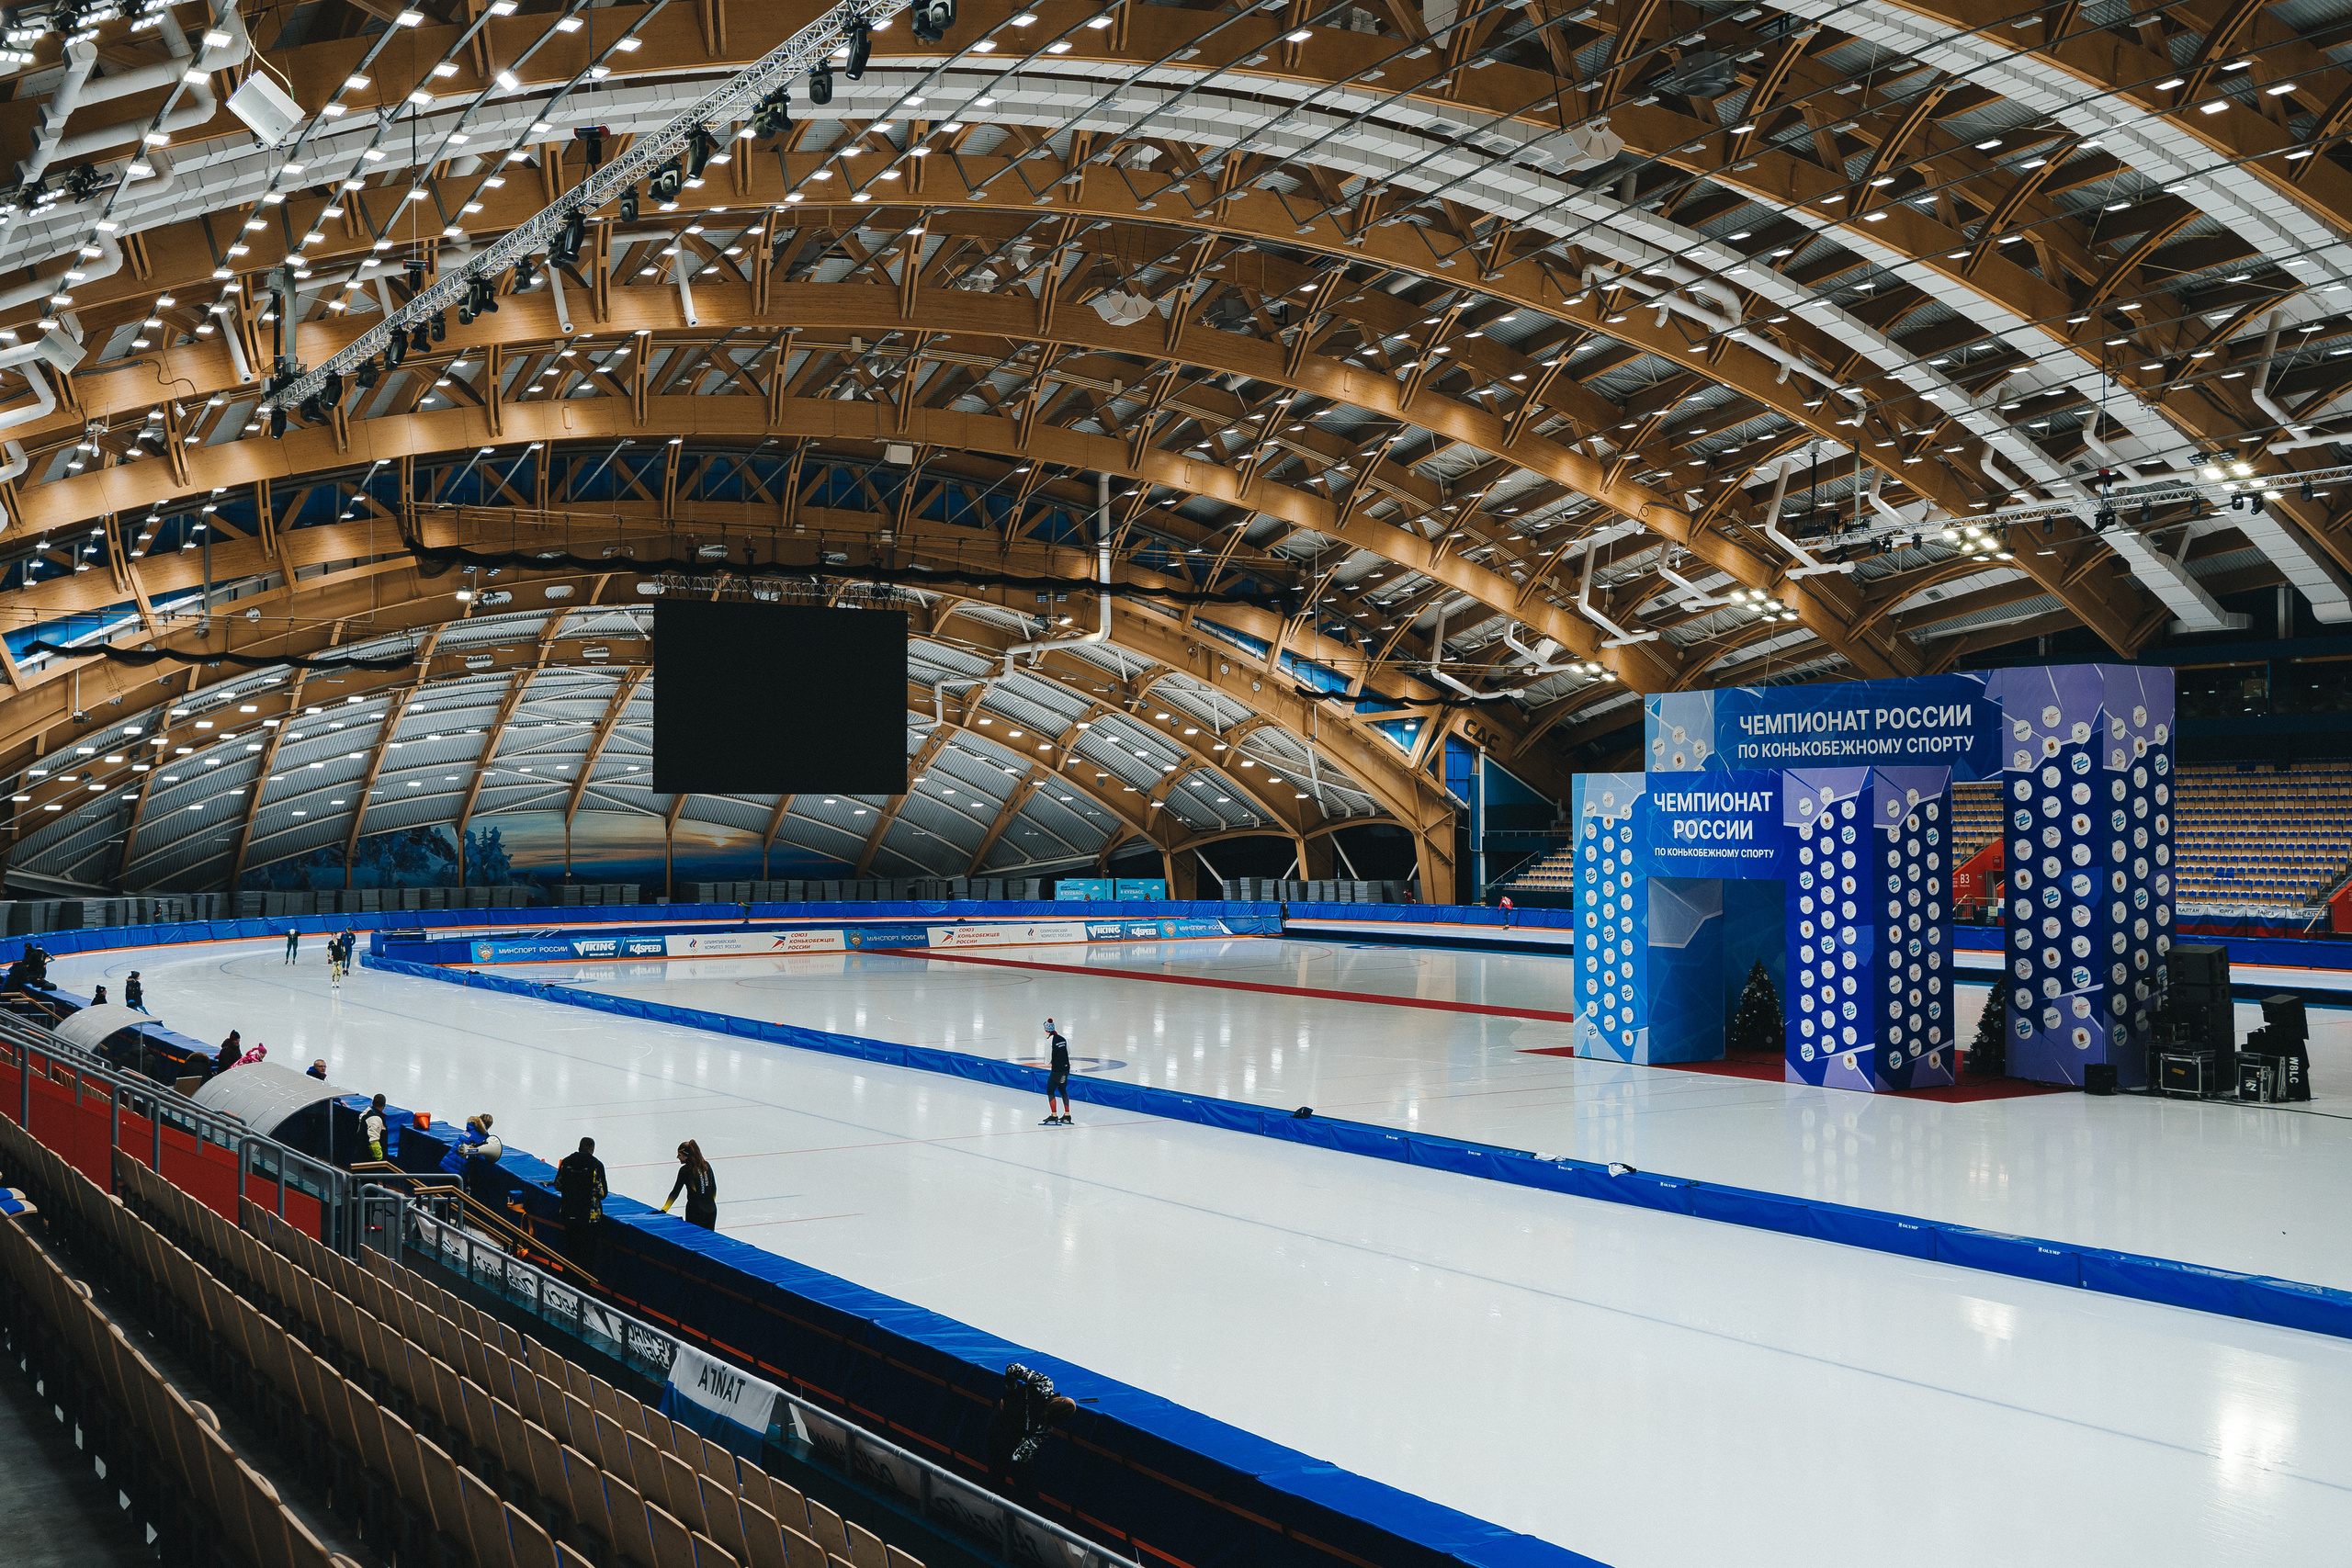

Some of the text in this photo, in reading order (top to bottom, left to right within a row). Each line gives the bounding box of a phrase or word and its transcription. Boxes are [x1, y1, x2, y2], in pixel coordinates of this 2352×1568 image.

[1739, 704, 1972, 736] ЧЕМПИОНАТ РОССИИ
[1738, 735, 1974, 759] ПО КОНЬКОБЕЖНОМУ СПОРТУ
[1654, 791, 1773, 812] ЧЕМПИОНАТ
[1673, 819, 1753, 840] РОССИИ
[1655, 847, 1774, 858] ПО КОНЬКОБЕЖНОМУ СПОРТУ
[1087, 924, 1121, 938] VIKING
[1132, 928, 1156, 937] K4SPEED
[573, 941, 616, 956] VIKING
[629, 943, 662, 954] K4SPEED
[2289, 1056, 2299, 1084] W8LC
